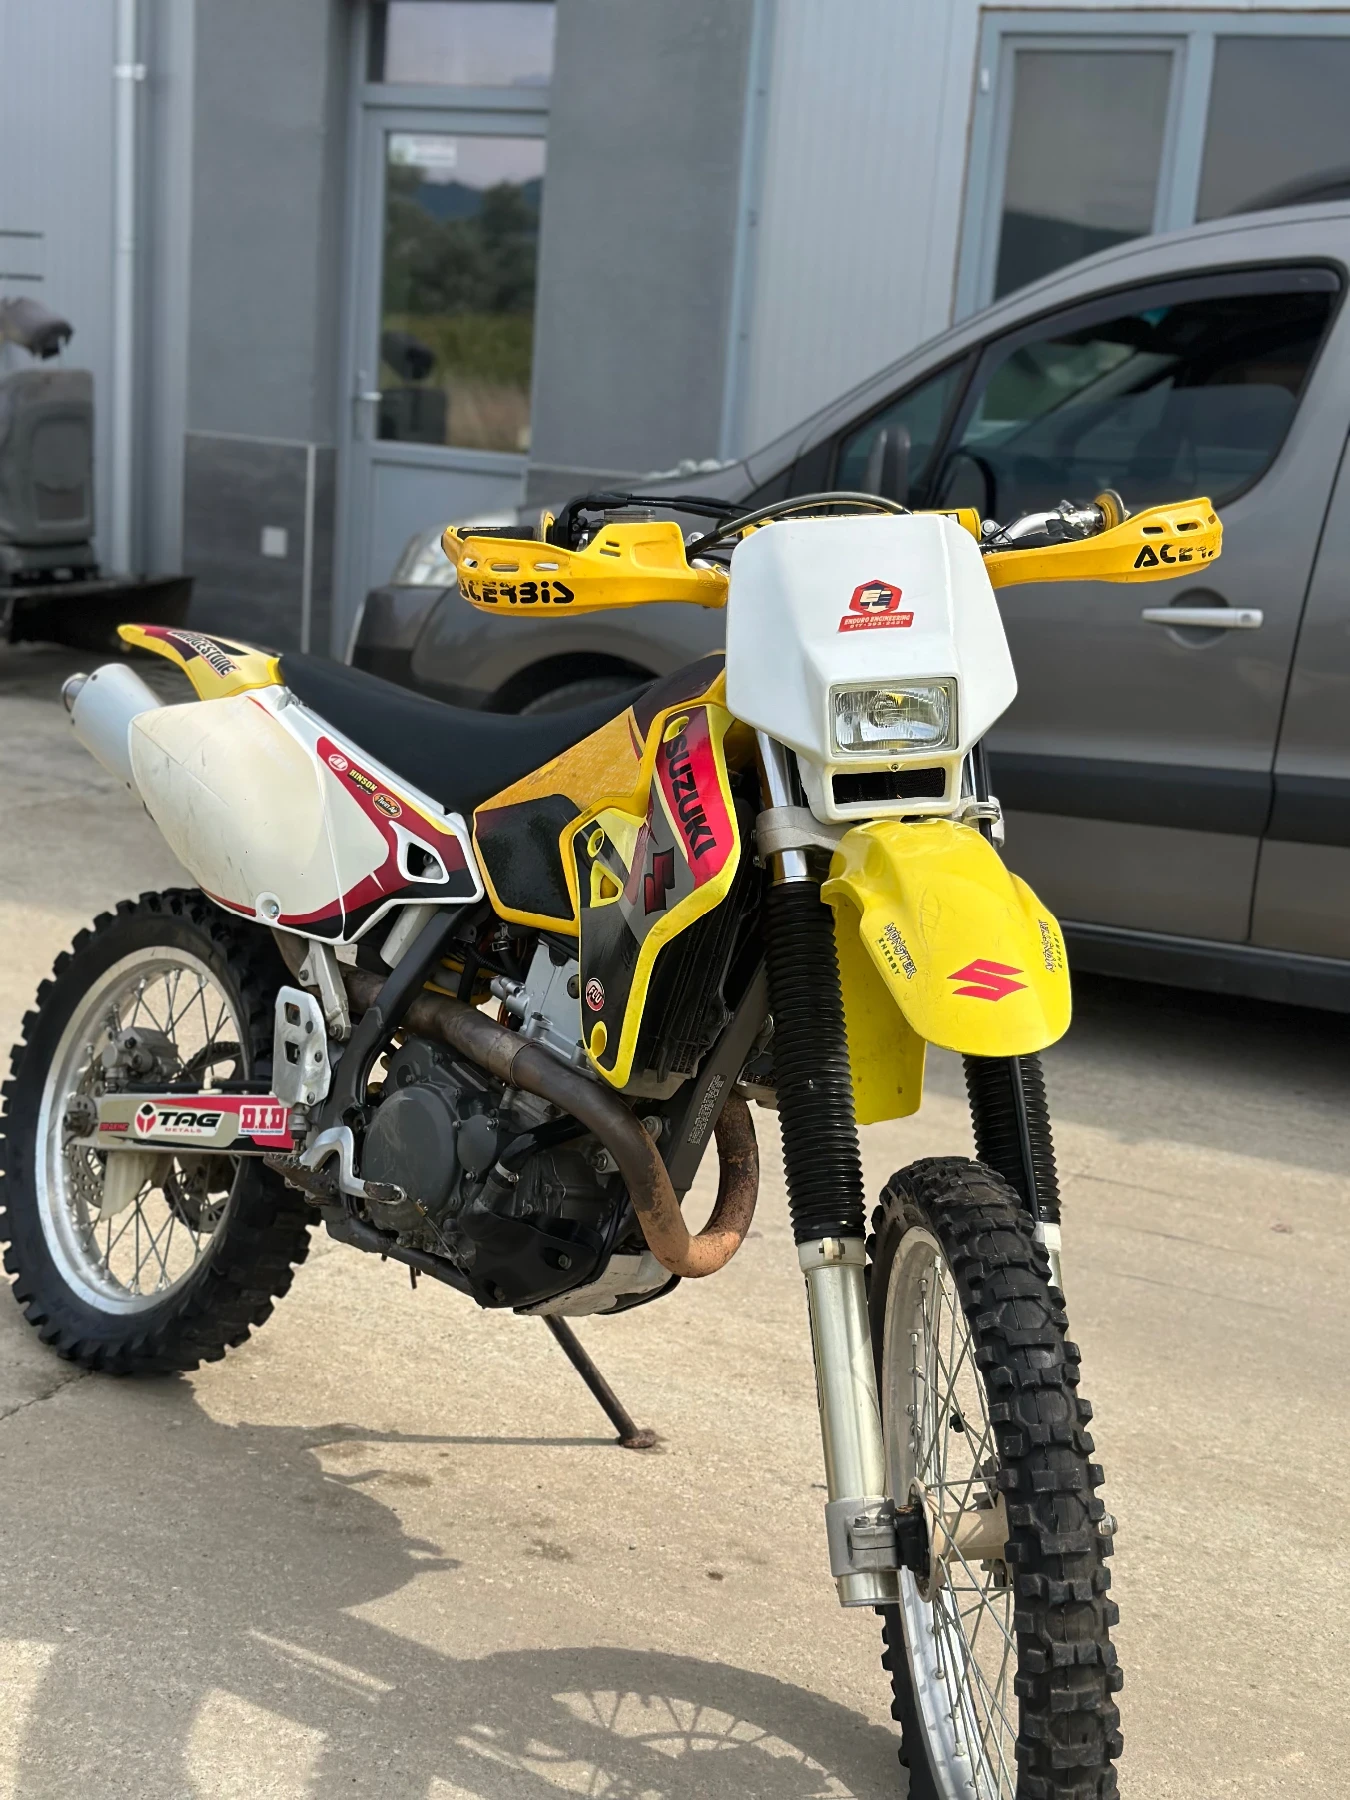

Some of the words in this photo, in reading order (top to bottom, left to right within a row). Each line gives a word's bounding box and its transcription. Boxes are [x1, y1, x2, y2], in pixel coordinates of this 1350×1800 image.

[844, 616, 869, 625] ENDURO
[349, 769, 378, 792] HINSON
[665, 734, 717, 860] SUZUKI
[879, 937, 901, 975] ENERGY
[884, 921, 917, 980] MONSTER
[157, 1111, 222, 1127] TAG
